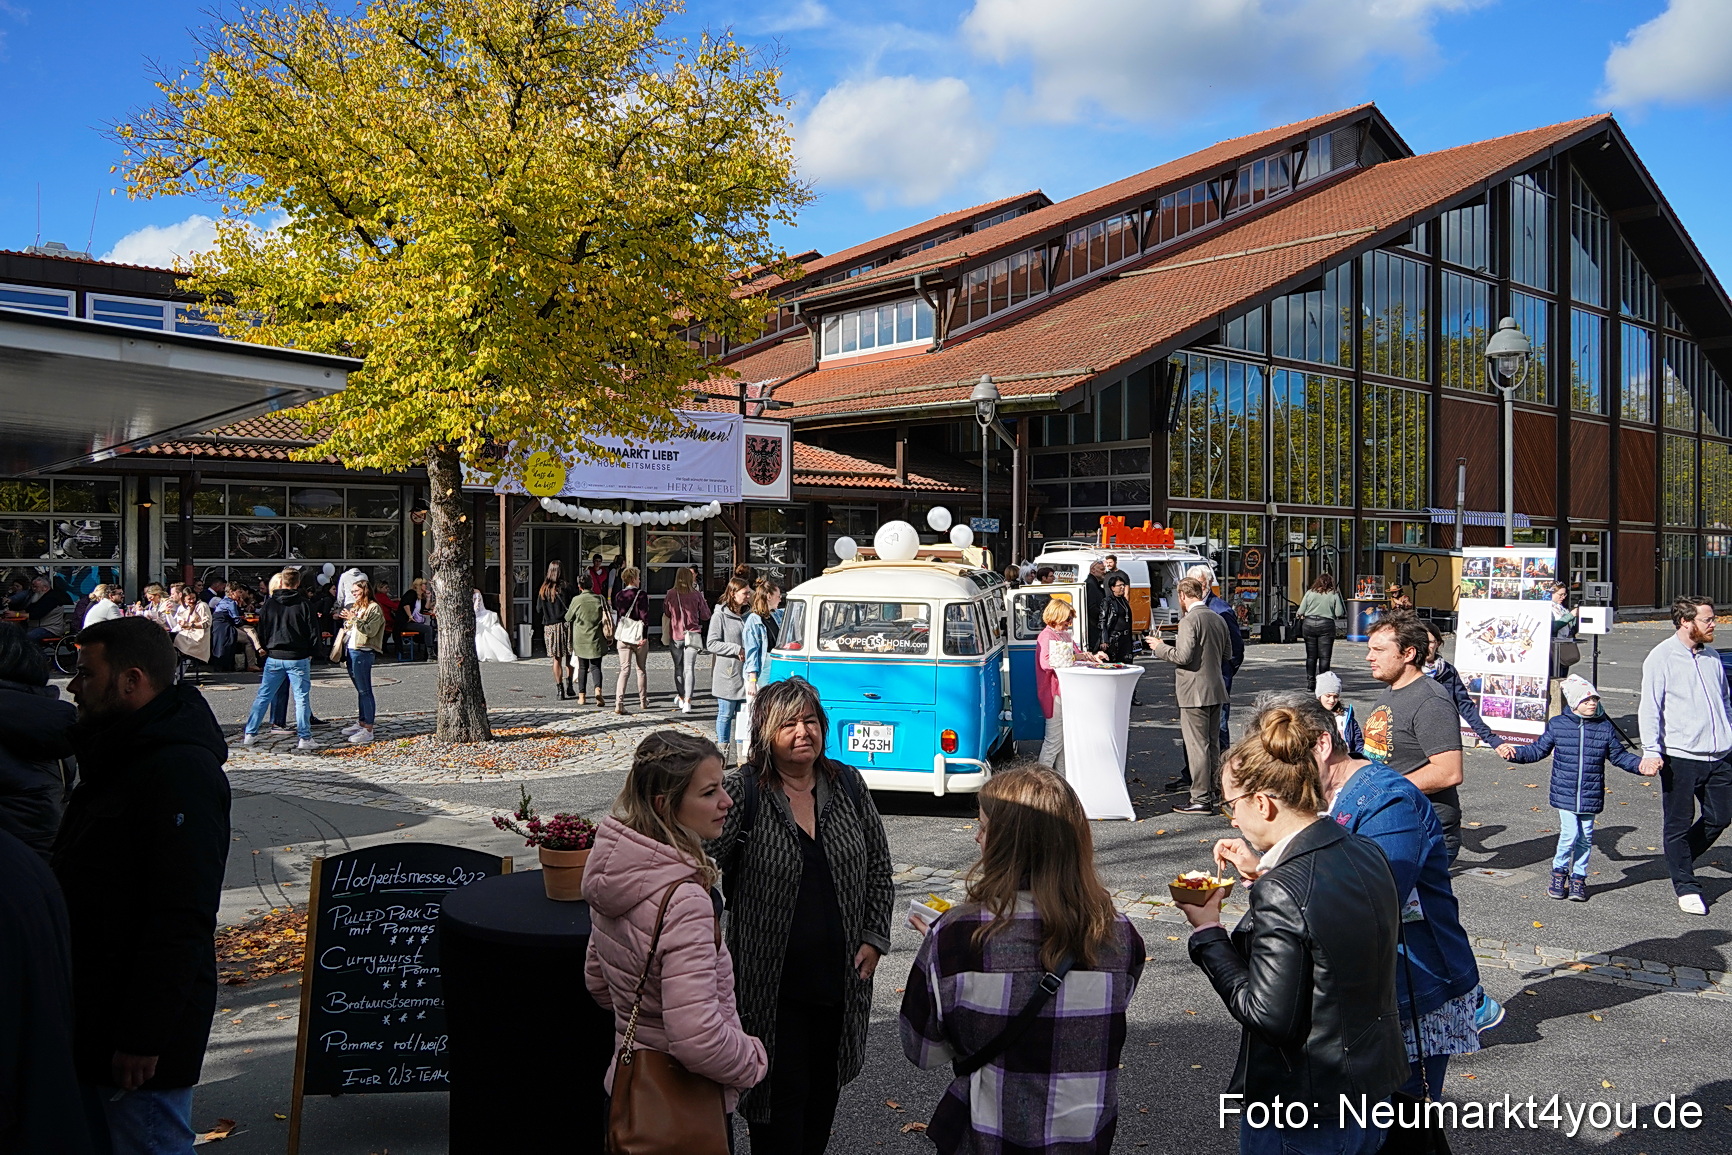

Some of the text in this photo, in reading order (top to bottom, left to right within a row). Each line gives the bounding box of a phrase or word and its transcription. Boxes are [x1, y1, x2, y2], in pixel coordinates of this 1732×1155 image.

[652, 450, 680, 461] LIEBT
[597, 459, 671, 471] HOCHEITSMESSE
[667, 482, 694, 492] HERZ
[707, 484, 735, 494] LIEBE
[862, 726, 870, 738] N
[852, 738, 891, 751] P 453H
[332, 859, 445, 892] Hochzeitsmesse
[349, 922, 436, 936] mit Pommes
[320, 946, 424, 975] Currywurst
[376, 962, 440, 978] mit Pomm
[320, 991, 445, 1014] Bratwurstsemme
[319, 1030, 385, 1053] Pommes
